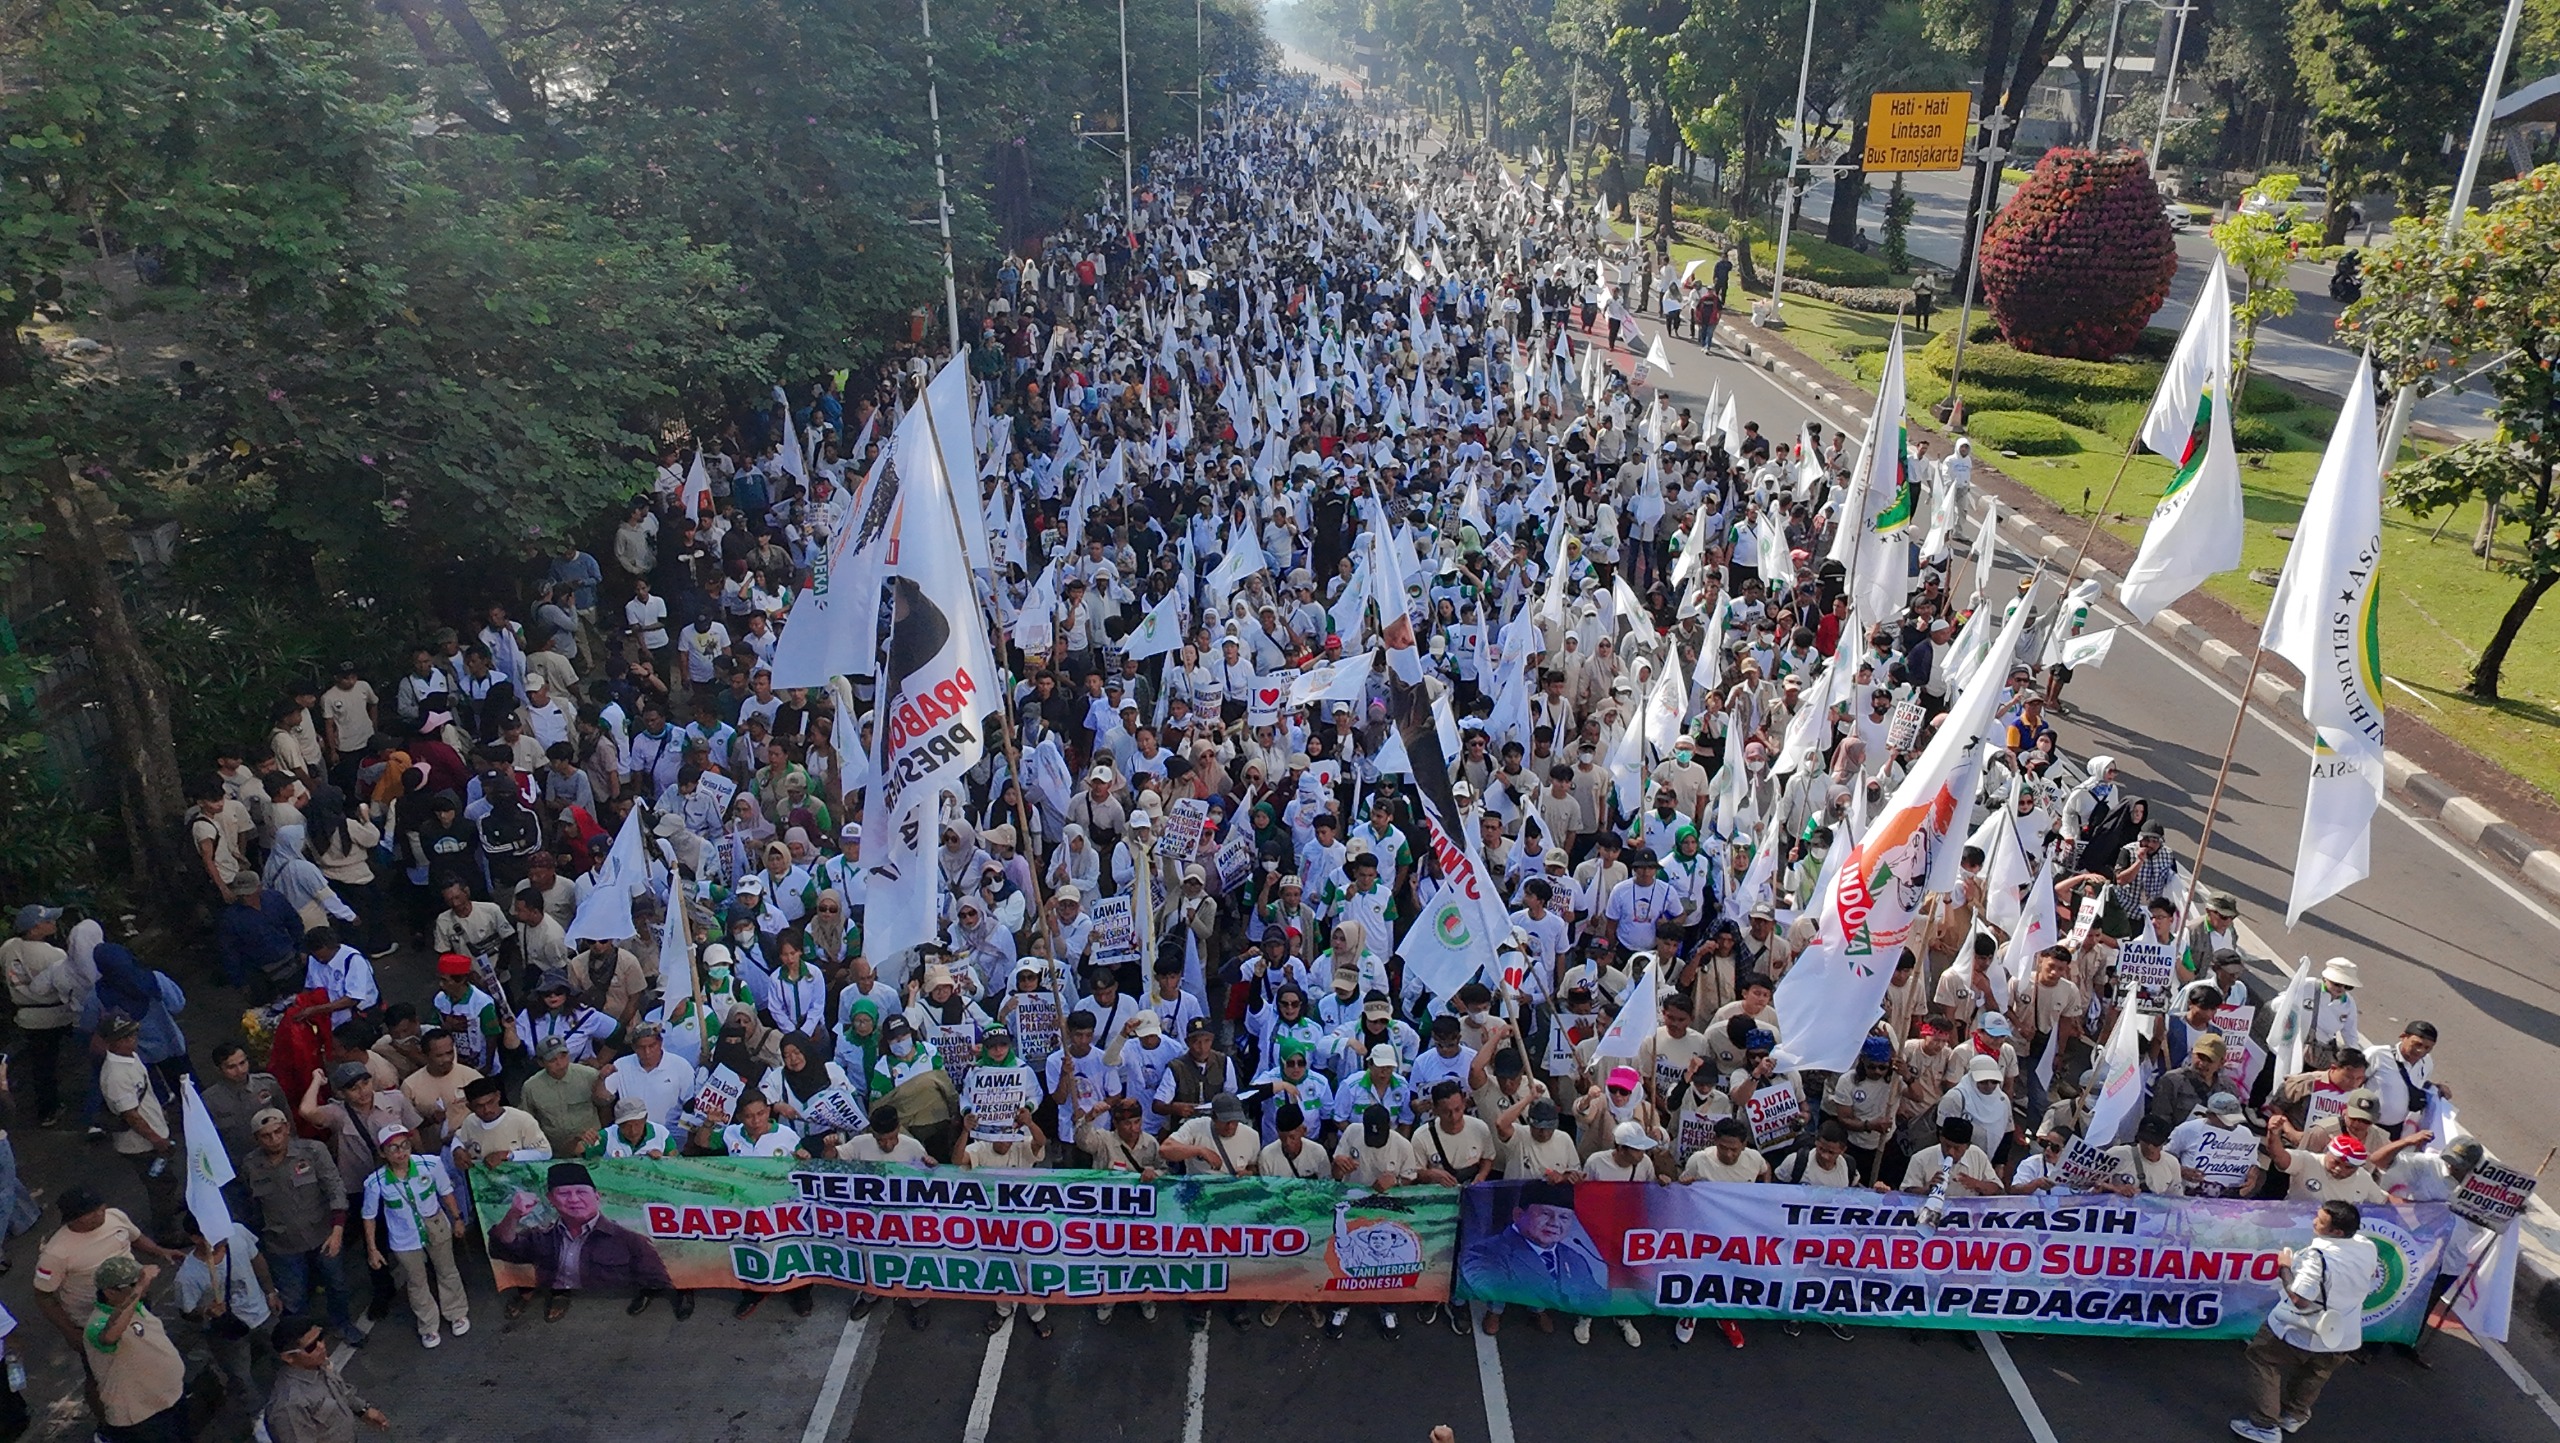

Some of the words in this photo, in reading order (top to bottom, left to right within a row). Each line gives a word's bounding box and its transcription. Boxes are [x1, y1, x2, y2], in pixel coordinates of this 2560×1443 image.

[1891, 97, 1915, 116] Hati
[1925, 97, 1949, 115] Hati
[1891, 122, 1941, 139] Lintasan
[1867, 148, 1886, 163] Bus
[1890, 146, 1958, 167] Transjakarta
[1896, 710, 1919, 722] SIAP
[1093, 901, 1128, 920] KAWAL
[2124, 943, 2162, 955] KAMI
[2122, 954, 2172, 966] DUKUNG
[2120, 974, 2169, 985] PRABOWO
[2121, 965, 2170, 977] PRESIDEN
[1018, 1004, 1056, 1014] DUKUNG
[931, 1036, 972, 1045] DUKUNG
[1554, 1028, 1563, 1051] I
[975, 1073, 1022, 1088] KAWAL
[701, 1088, 727, 1109] PAK
[975, 1103, 1020, 1113] PRESIDEN
[1747, 1099, 1765, 1123] 3
[1762, 1089, 1791, 1109] JUTA
[828, 1092, 863, 1129] KAWAL
[1764, 1099, 1797, 1119] RUMAH
[1681, 1129, 1715, 1139] PRESID
[2199, 1132, 2257, 1156] Pedagang
[2068, 1152, 2116, 1172] RAKYAT
[2073, 1141, 2120, 1167] UANG
[2195, 1156, 2249, 1174] Prabowo
[2473, 1160, 2537, 1191] Jangan
[790, 1172, 988, 1208] TERIMA
[998, 1181, 1153, 1214] KASIH
[2465, 1176, 2526, 1207] hentikan
[2457, 1189, 2518, 1217] program
[647, 1204, 809, 1239] BAPAK
[815, 1204, 1056, 1251] PRABOWO
[1062, 1220, 1308, 1255] SUBIANTO
[1980, 1208, 2137, 1235] KASIH
[1626, 1231, 1784, 1267] BAPAK
[1792, 1237, 2032, 1273] PRABOWO
[2040, 1243, 2280, 1283] SUBIANTO
[733, 1244, 866, 1283] DARI
[872, 1252, 1026, 1294] PARA
[1029, 1260, 1227, 1296] PETANI
[1352, 1266, 1375, 1278] TANI
[1376, 1263, 1424, 1276] MERDEKA
[1336, 1277, 1404, 1290] INDONESIA
[1657, 1273, 1783, 1309] DARI
[1792, 1279, 1927, 1313] PARA
[1936, 1286, 2220, 1327] PEDAGANG
